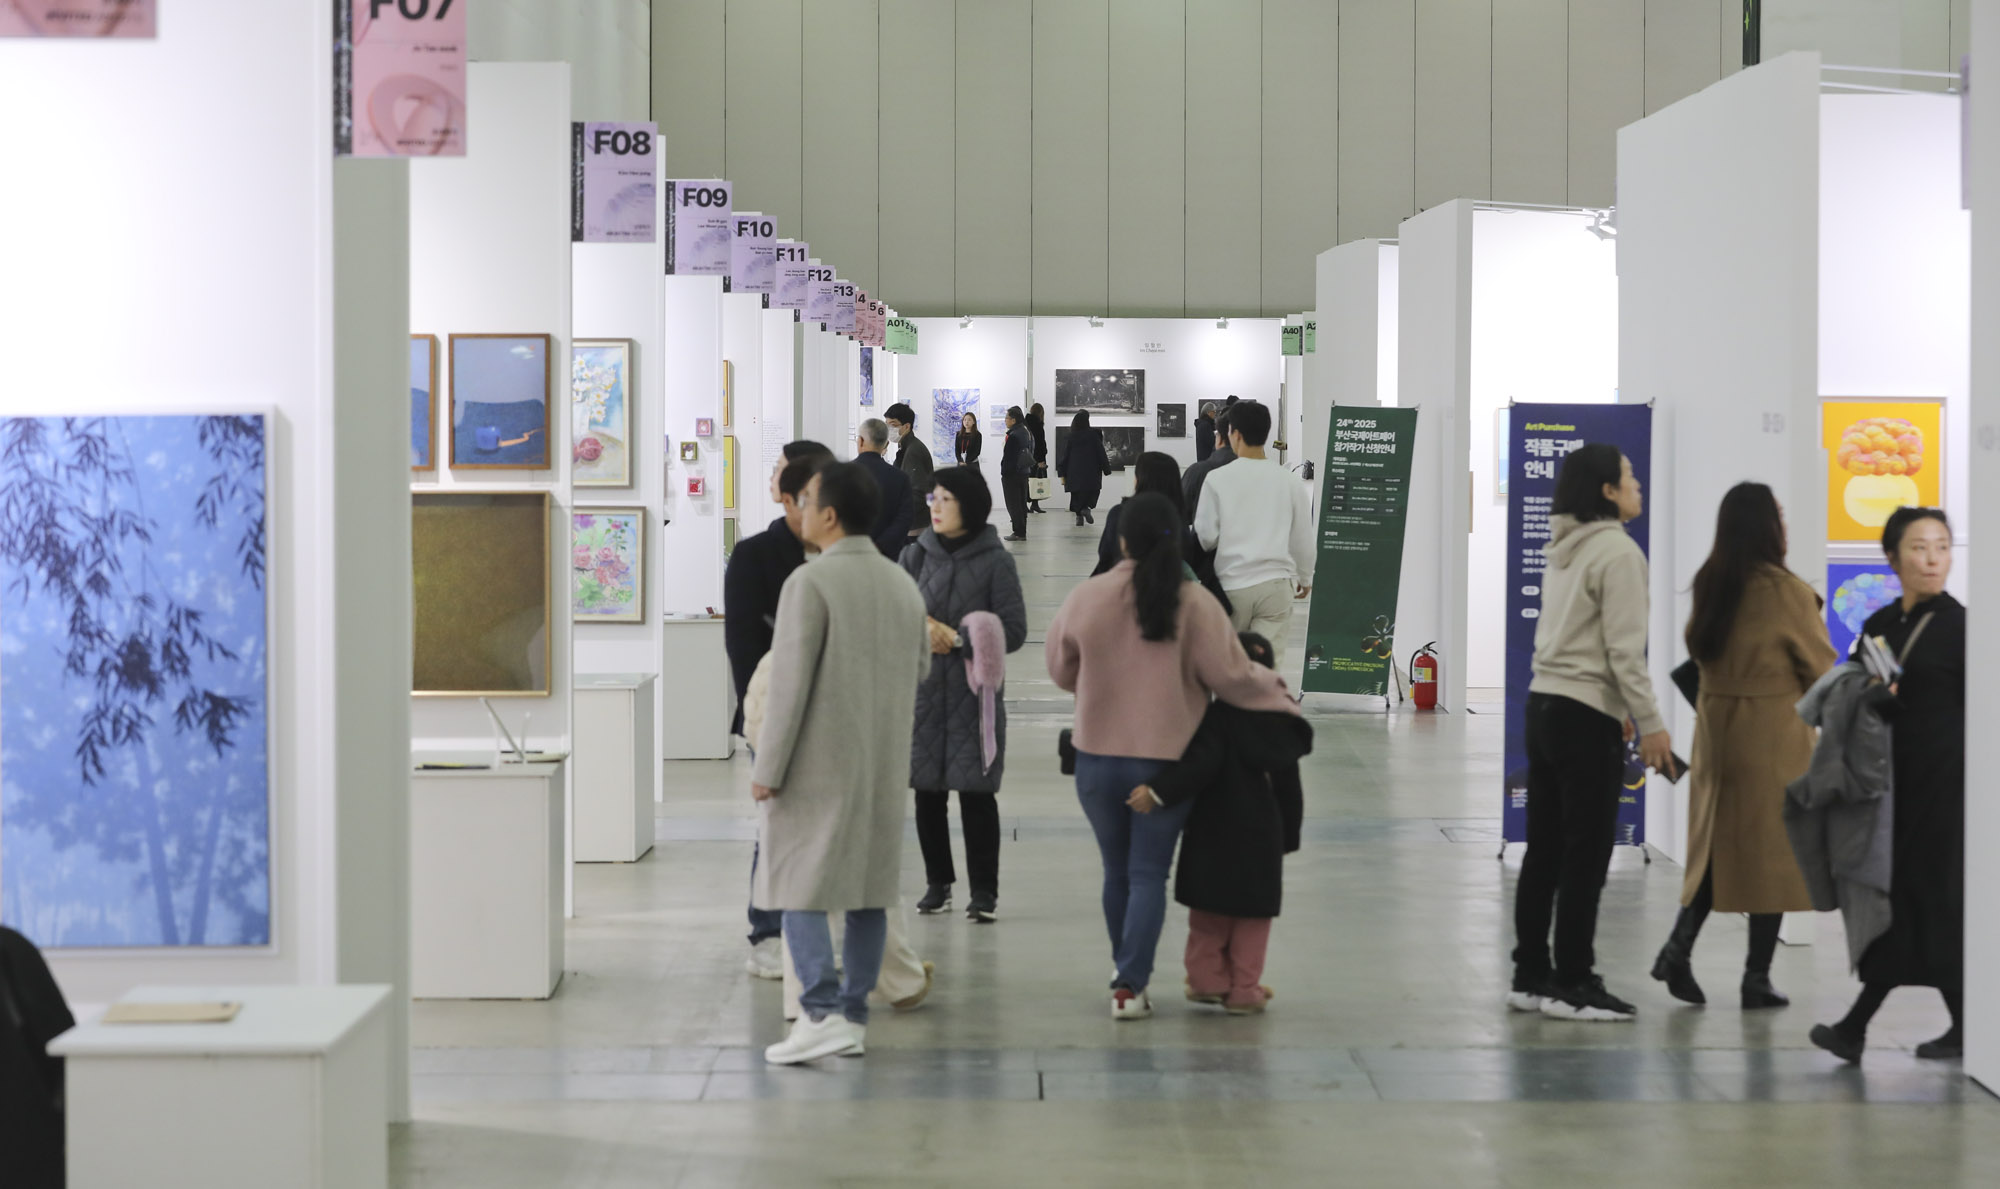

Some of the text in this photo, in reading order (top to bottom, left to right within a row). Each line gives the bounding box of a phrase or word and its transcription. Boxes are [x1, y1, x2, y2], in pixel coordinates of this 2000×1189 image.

[594, 130, 651, 155] F08
[683, 187, 728, 207] F09
[737, 220, 774, 238] F10
[776, 247, 805, 262] F11
[808, 269, 832, 282] F12
[833, 285, 854, 297] F13
[887, 319, 905, 327] A01
[1282, 327, 1299, 335] A40
[1354, 419, 1377, 428] 2025
[1524, 422, 1576, 432] Art Purchase
[1335, 429, 1396, 442] 부산국제아트페어
[1523, 460, 1555, 479] 안내
